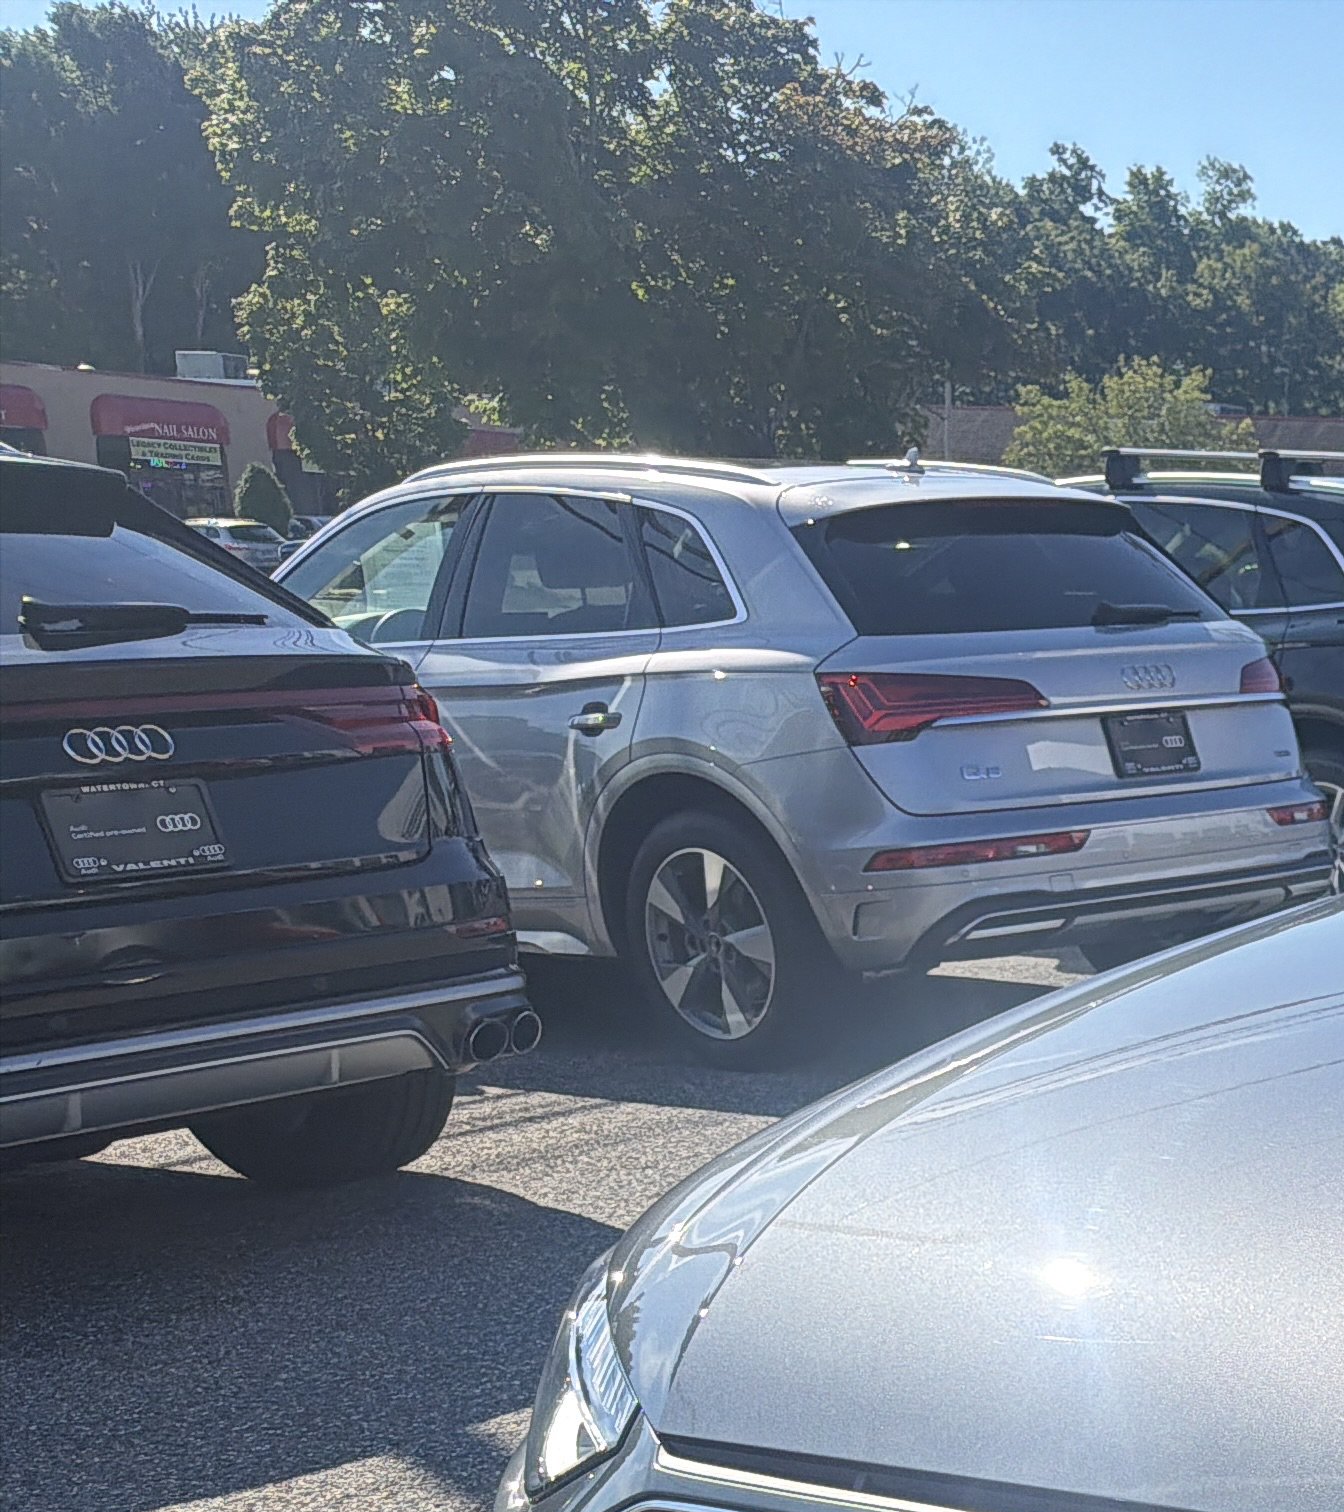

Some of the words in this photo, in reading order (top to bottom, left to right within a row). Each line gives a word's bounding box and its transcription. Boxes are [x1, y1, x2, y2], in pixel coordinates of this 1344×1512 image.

[155, 424, 179, 437] NAIL
[182, 426, 217, 440] SALON
[151, 780, 166, 788] CT
[71, 830, 104, 840] Certified
[207, 853, 223, 861] Audi
[111, 857, 195, 872] VALENTI
[81, 867, 98, 875] Audi
